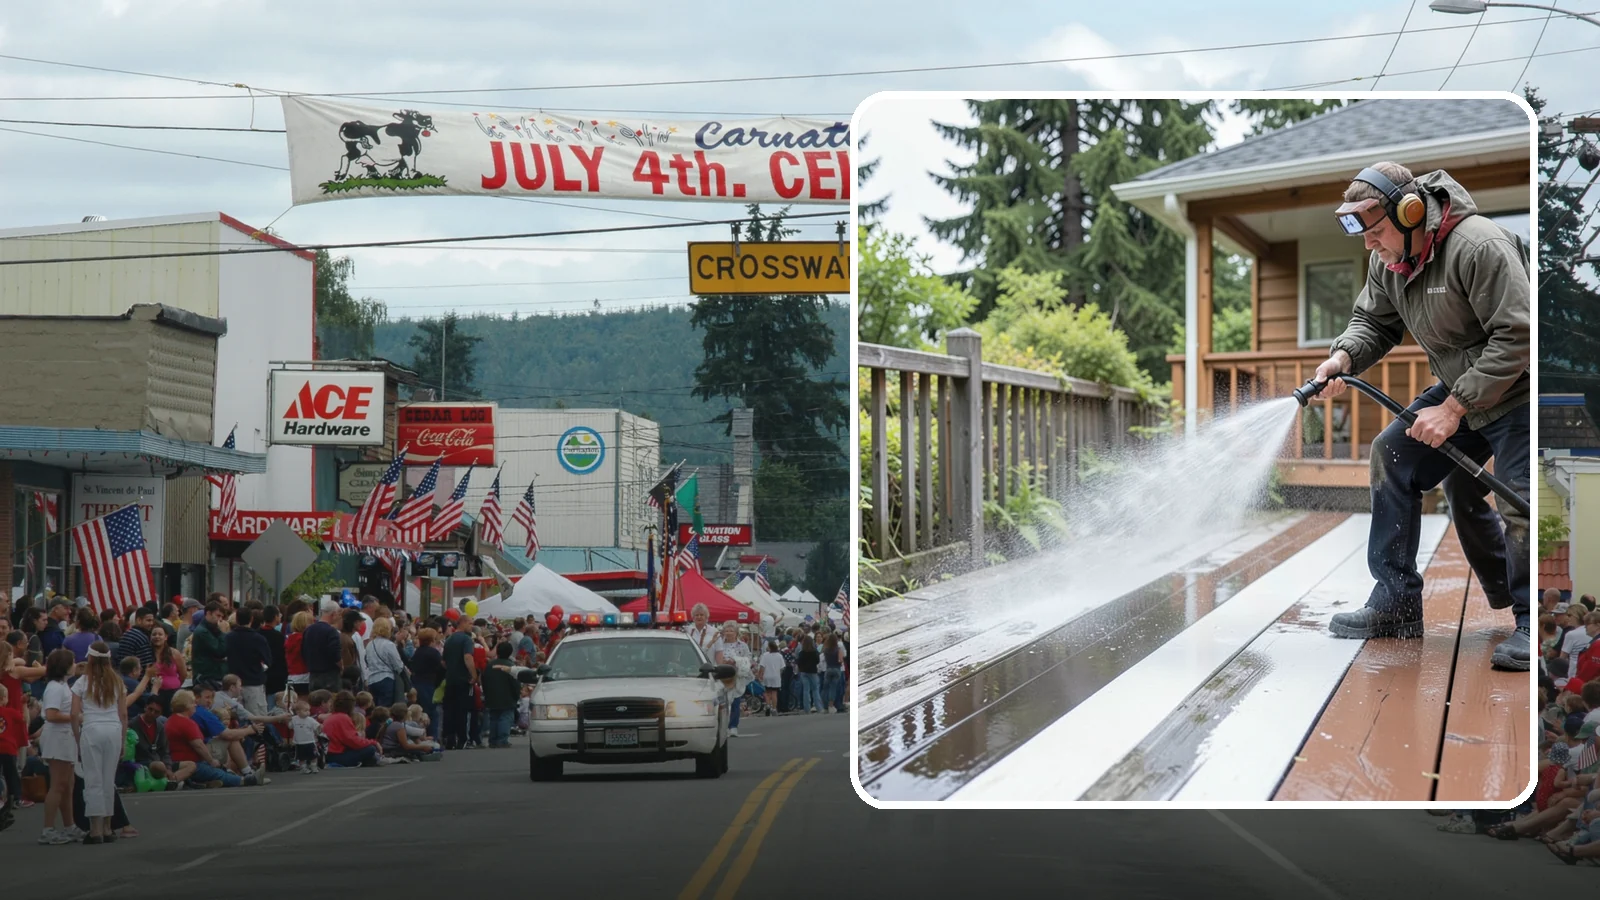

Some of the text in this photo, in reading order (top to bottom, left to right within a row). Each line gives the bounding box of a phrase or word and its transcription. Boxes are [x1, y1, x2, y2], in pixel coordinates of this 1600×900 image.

[481, 140, 605, 192] JULY
[632, 150, 747, 197] 4th.
[696, 254, 850, 280] CROSSWA
[282, 380, 373, 420] ACE
[405, 409, 453, 422] CEDAR
[283, 421, 371, 436] Hardware
[83, 486, 155, 495] St. Vincent de Paul
[81, 503, 153, 521] THT
[213, 516, 331, 535] HRDARE
[688, 526, 741, 535] CRNATION
[699, 535, 730, 543] GLASS
